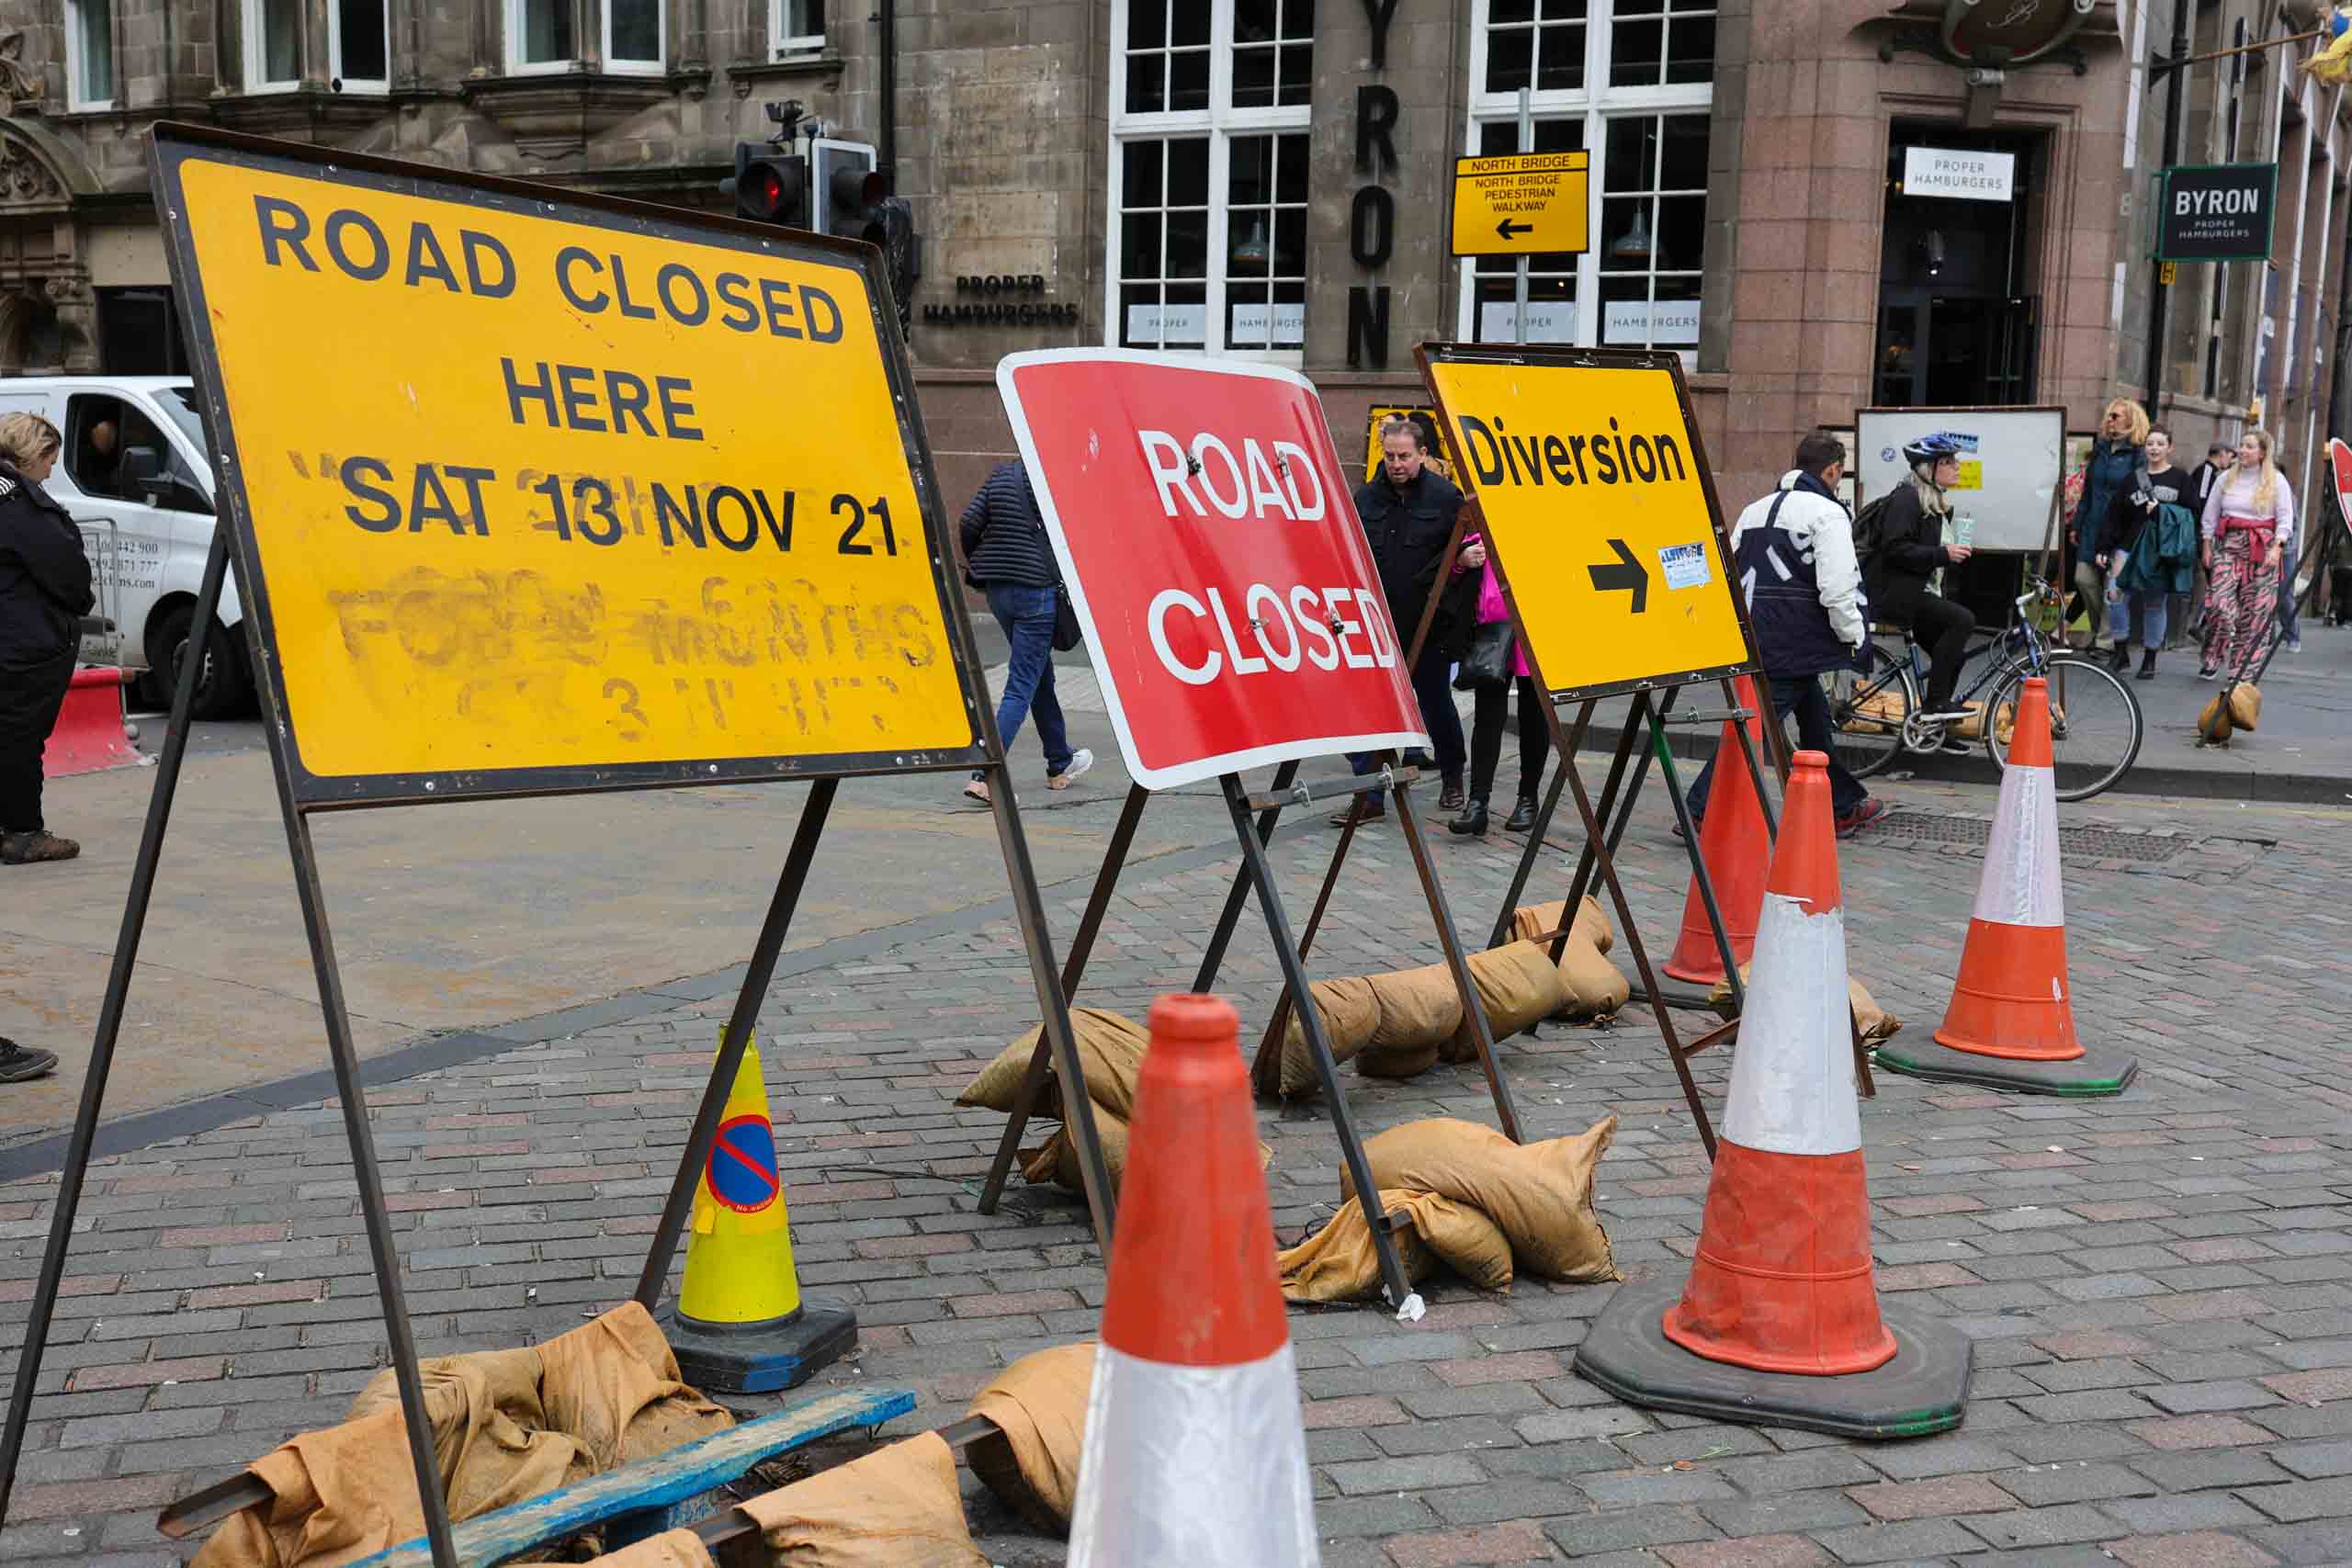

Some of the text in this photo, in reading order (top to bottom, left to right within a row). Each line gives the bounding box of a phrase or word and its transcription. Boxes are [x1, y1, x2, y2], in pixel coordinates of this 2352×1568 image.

[1471, 155, 1571, 172] NORTH BRIDGE
[1934, 160, 1985, 173] PROPER
[1476, 174, 1561, 189] NORTH BRIDGE
[1915, 175, 2003, 190] HAMBURGERS
[1485, 187, 1555, 200] PEDESTRIAN
[2175, 188, 2259, 215] BYRON
[1492, 200, 1547, 212] WALKWAY
[2194, 220, 2235, 229] PROPER
[2178, 229, 2250, 239] HAMBURGERS
[254, 194, 844, 344] ROAD CLOSED
[1507, 317, 1552, 328] PPER
[500, 356, 705, 442] HERE
[1457, 415, 1686, 486] Diversion
[1138, 429, 1326, 521] ROAD
[339, 456, 898, 557] SAT 13 NOV 21
[1148, 583, 1396, 684] CLOSED
